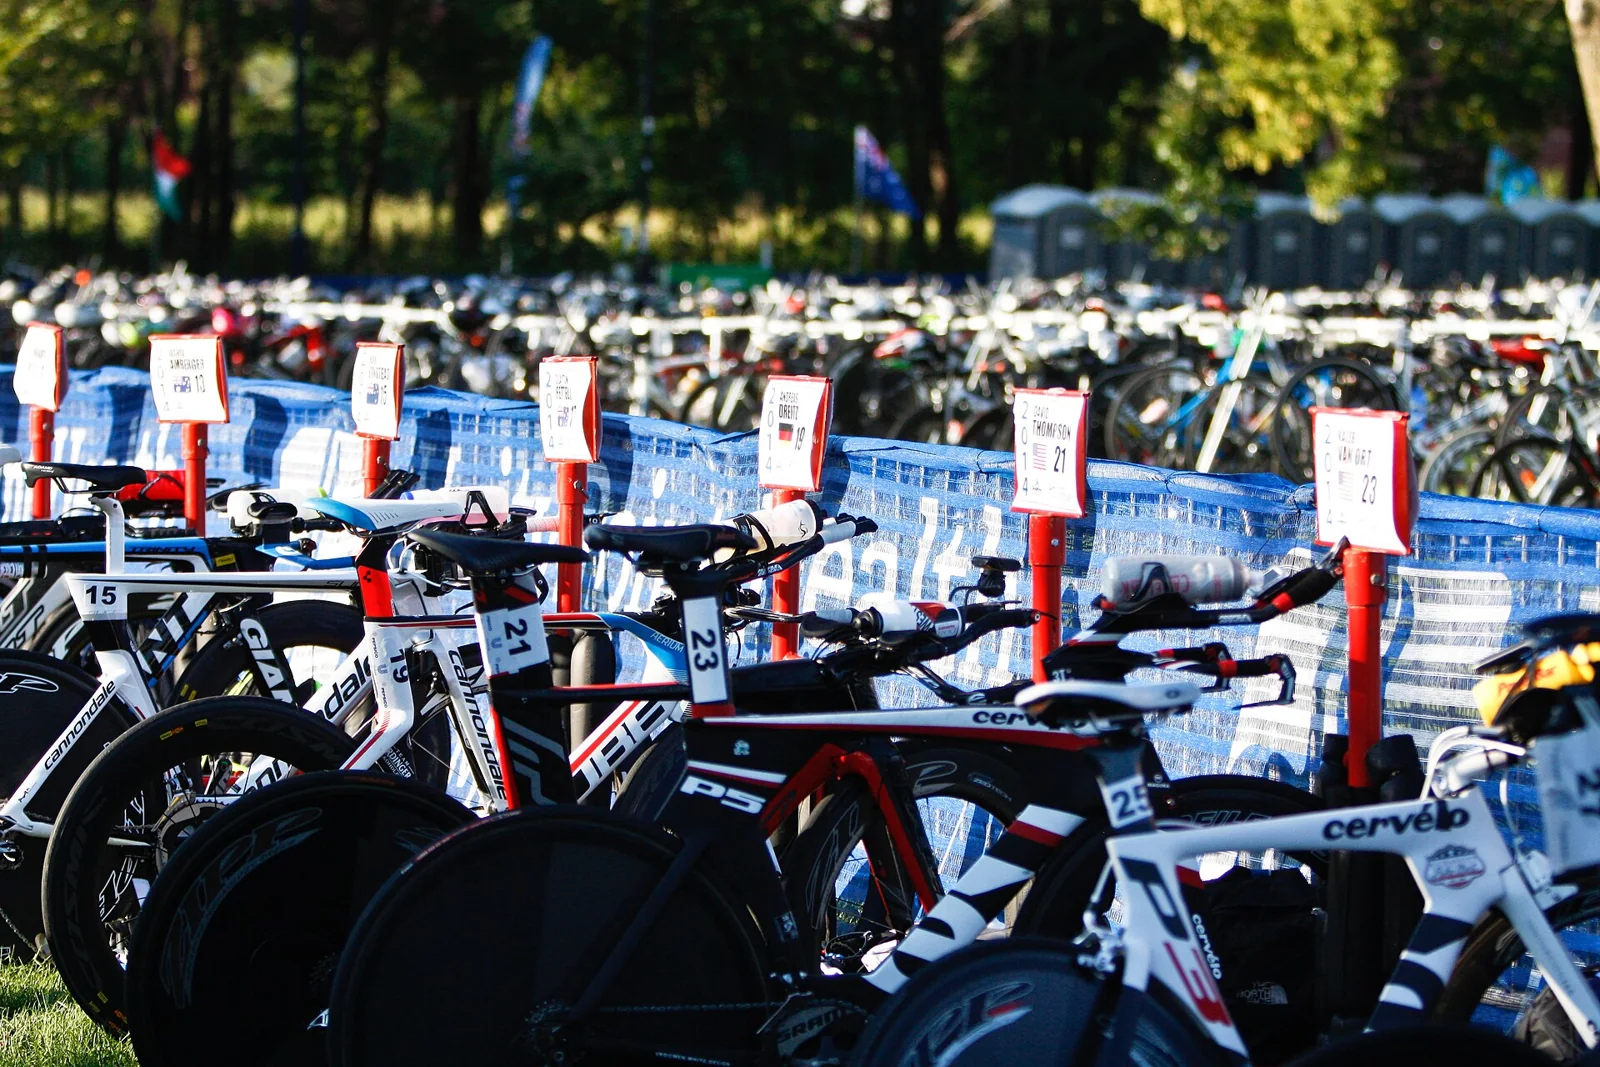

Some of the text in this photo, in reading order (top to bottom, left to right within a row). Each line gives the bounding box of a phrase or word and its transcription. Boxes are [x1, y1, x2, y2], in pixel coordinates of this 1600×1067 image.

[194, 373, 206, 393] 13
[778, 403, 799, 420] DREITZ
[794, 426, 806, 451] 19
[1032, 419, 1071, 441] THOMPSON
[1053, 445, 1067, 474] 21
[1338, 445, 1372, 467] VAN ORT
[1361, 473, 1378, 505] 23
[85, 585, 117, 606] 15
[503, 618, 532, 656] 21
[650, 631, 686, 654] AERIUM
[690, 628, 720, 673] 23
[44, 680, 116, 771] cannondale
[387, 746, 413, 779] RDINGER
[680, 775, 767, 814] P5
[1110, 785, 1151, 821] 25
[1191, 913, 1223, 980] cervélo
[776, 1005, 853, 1042] SRAM
